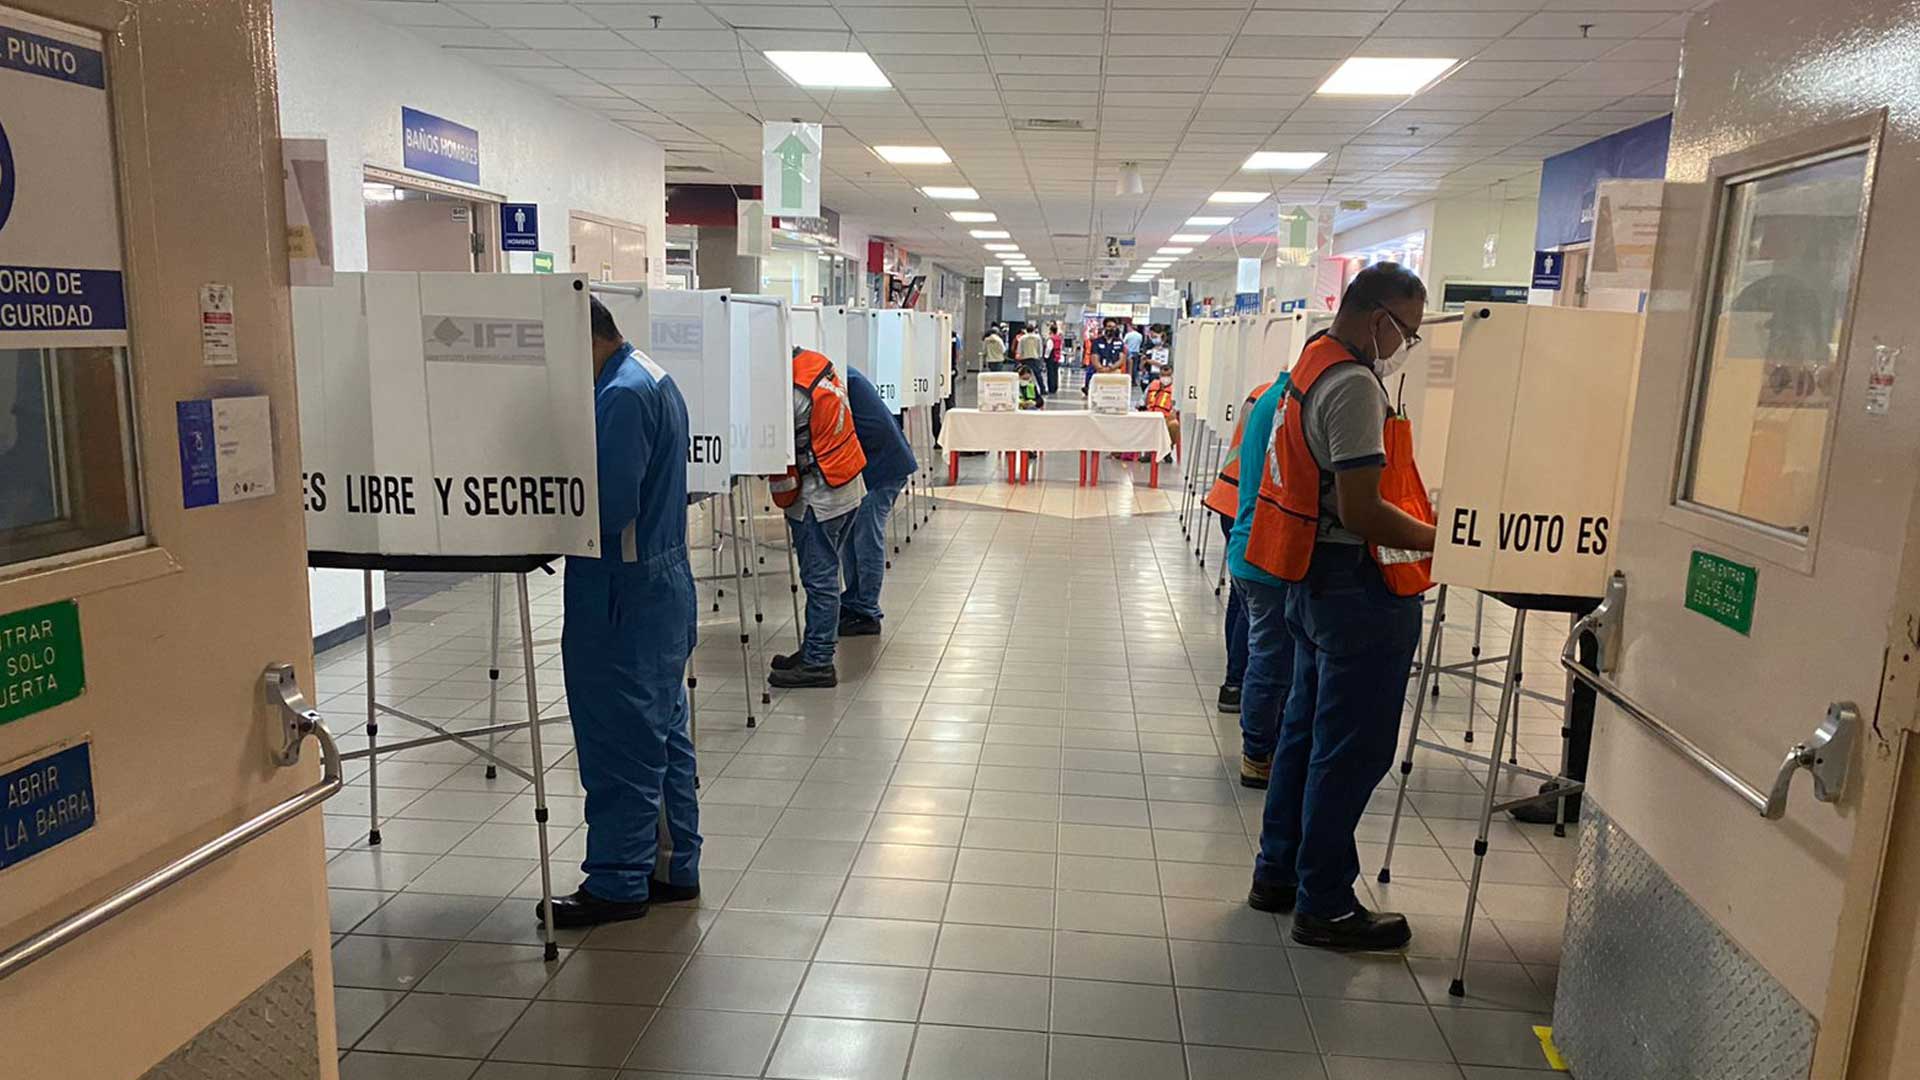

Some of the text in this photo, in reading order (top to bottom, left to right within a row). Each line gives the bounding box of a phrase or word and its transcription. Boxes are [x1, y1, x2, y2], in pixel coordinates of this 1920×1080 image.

[8, 36, 77, 74] PUNTO
[405, 127, 439, 154] BAÑOS
[55, 272, 83, 294] DE
[1, 303, 93, 327] GURIDAD
[473, 322, 544, 348] IFE
[346, 474, 416, 515] LIBRE
[434, 477, 453, 515] Y
[464, 476, 586, 517] SECRETO
[1451, 508, 1609, 555] EL VOTO ES
[0, 619, 54, 652] TRAR
[7, 646, 55, 677] SOLO
[8, 765, 59, 809] ABRIR
[3, 789, 91, 851] LA BARRA
